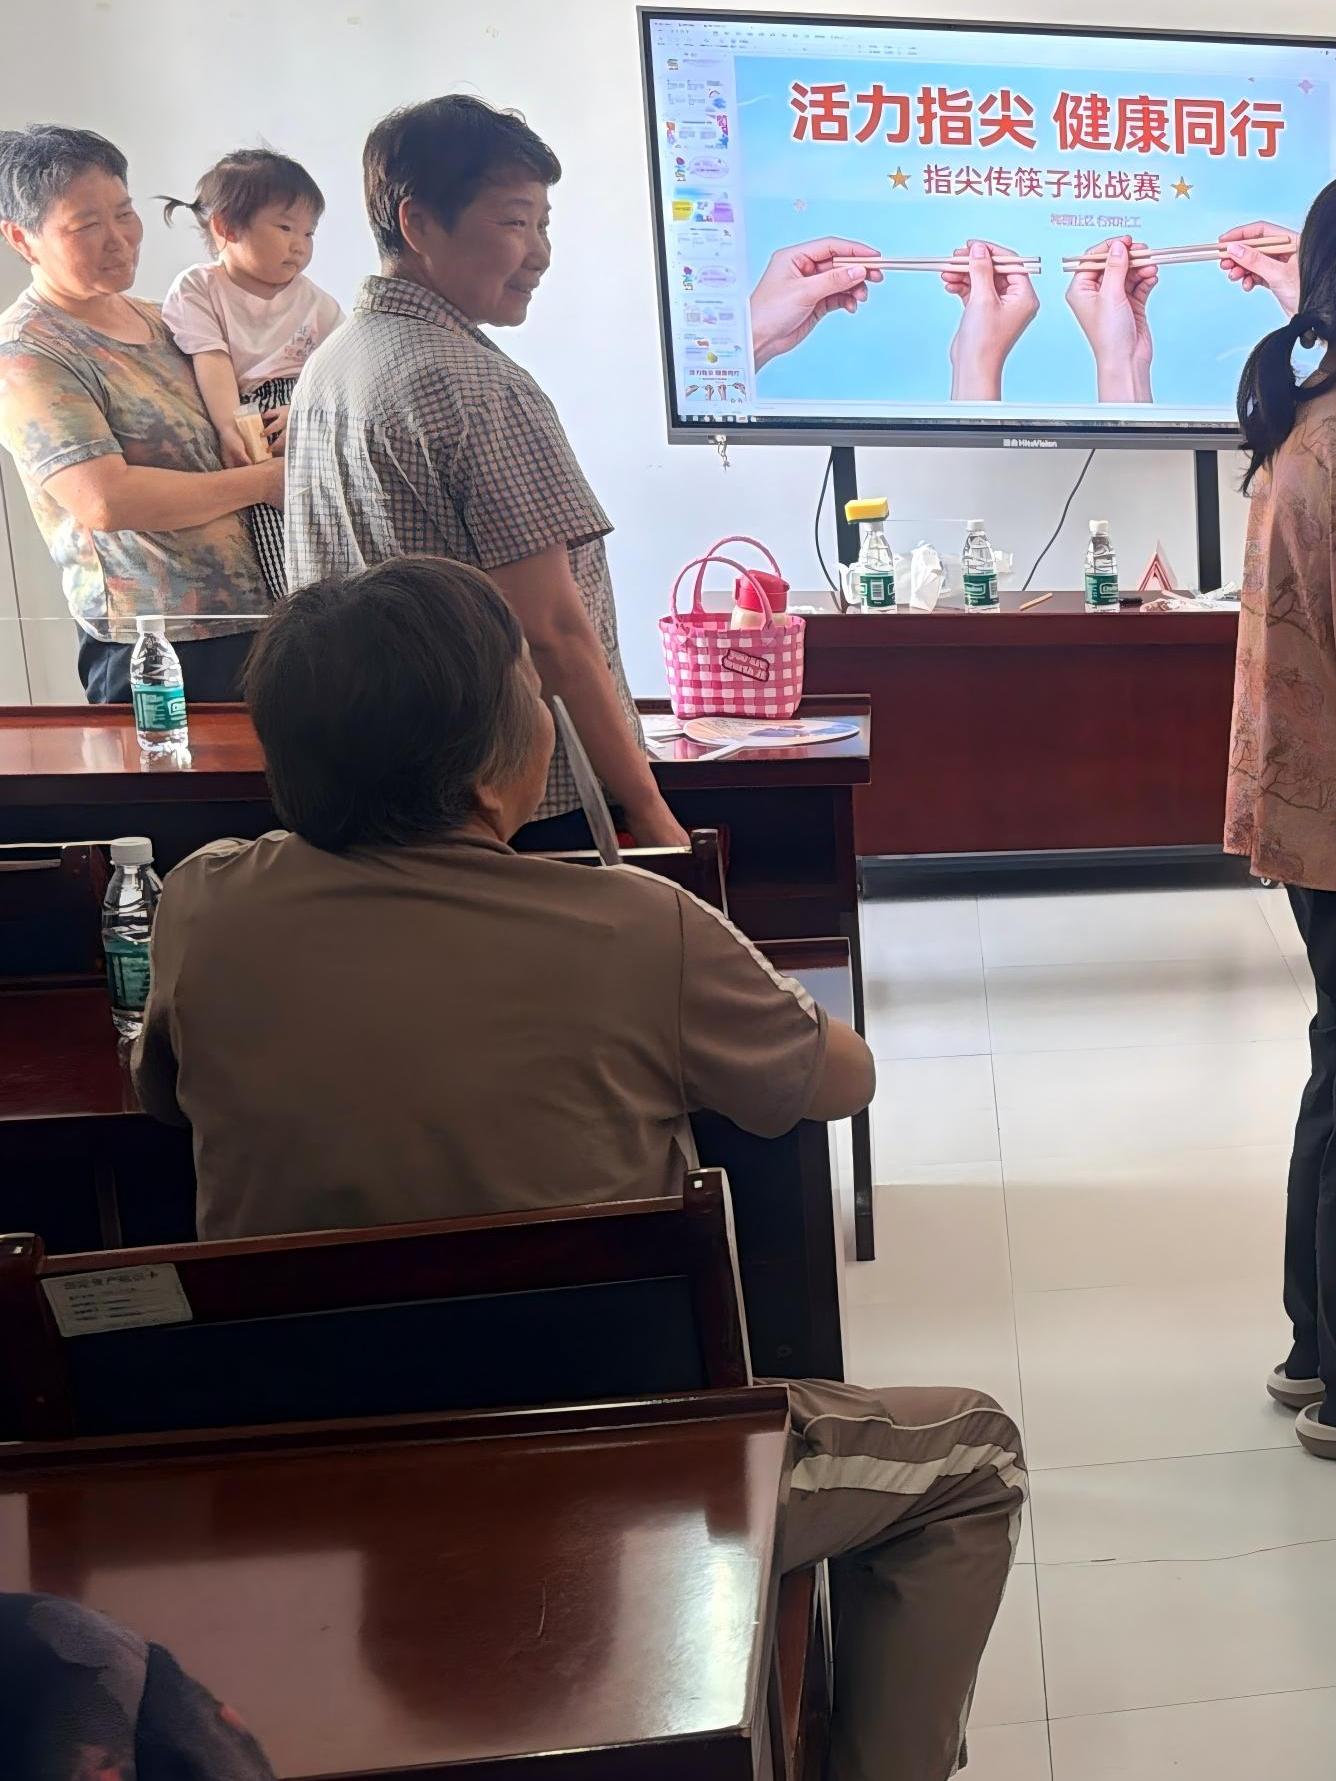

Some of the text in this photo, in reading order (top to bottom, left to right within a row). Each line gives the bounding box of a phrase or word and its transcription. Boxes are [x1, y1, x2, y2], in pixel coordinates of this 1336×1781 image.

[790, 82, 1285, 158] 活力指尖 健康同行
[924, 164, 1161, 201] 指尖传筷子挑战赛
